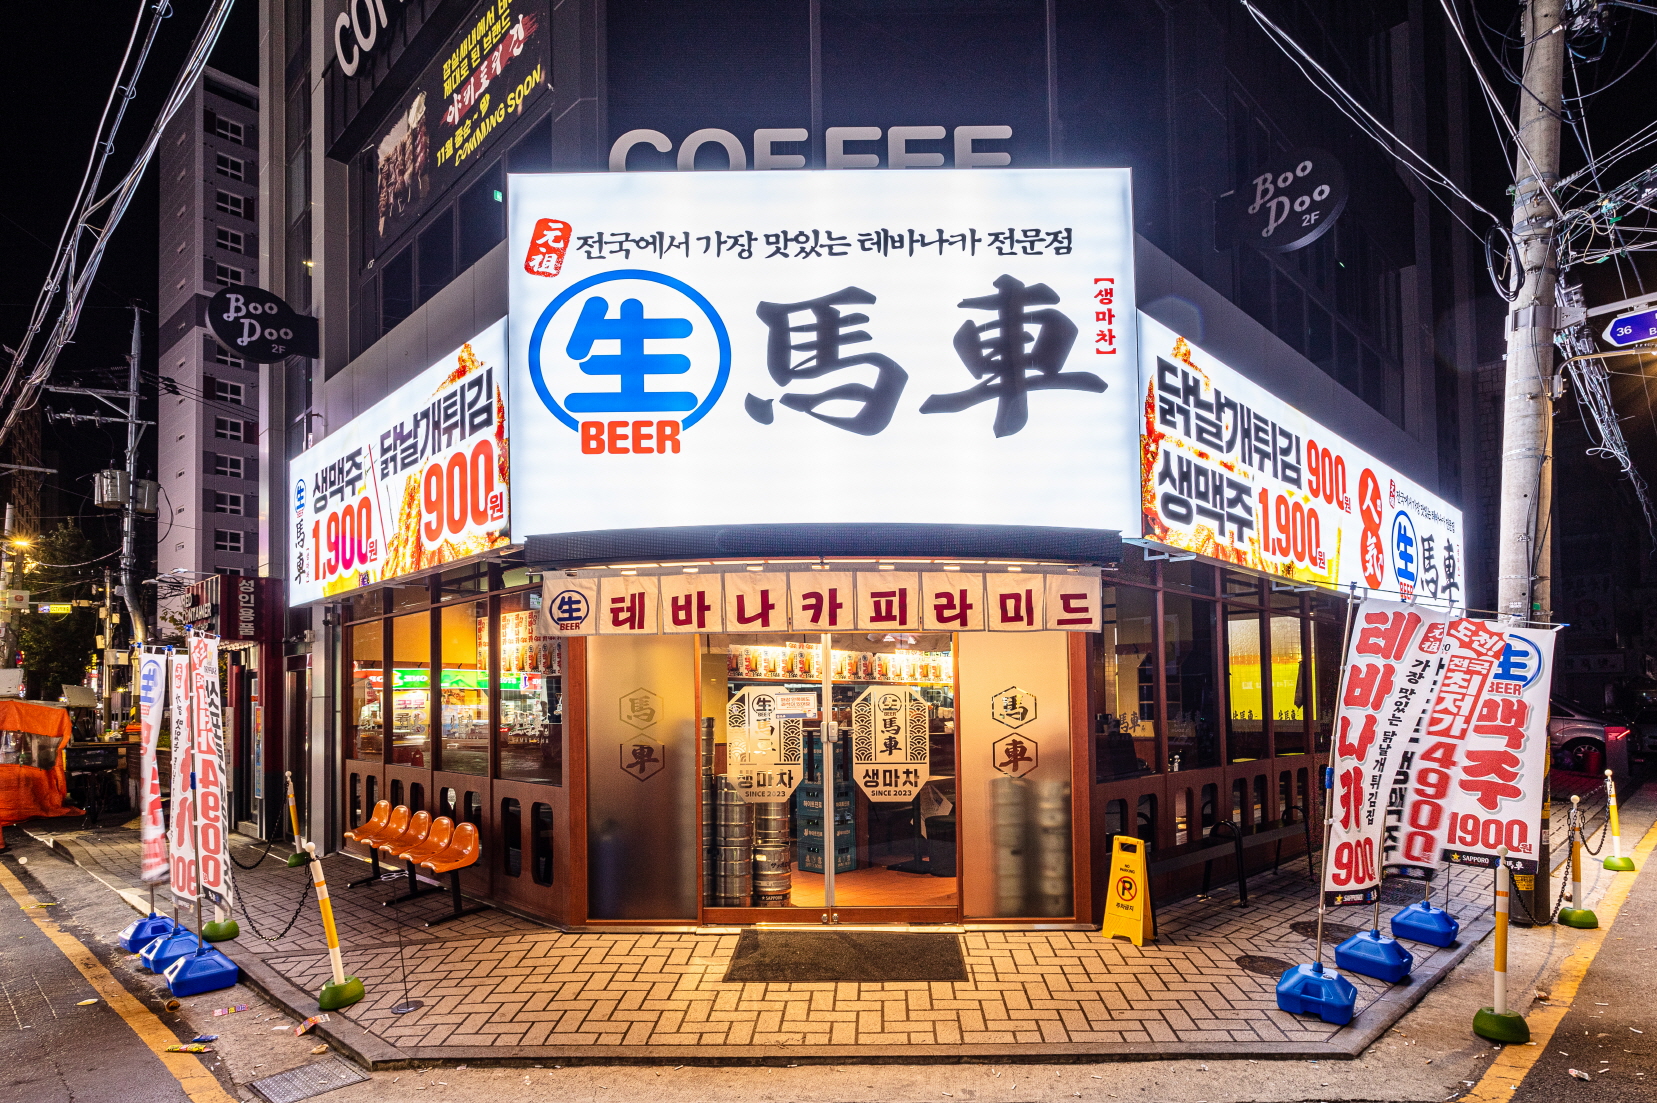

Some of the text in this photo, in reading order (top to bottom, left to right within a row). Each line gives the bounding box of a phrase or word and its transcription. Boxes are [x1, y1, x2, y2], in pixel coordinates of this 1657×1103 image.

[443, 58, 470, 99] 제대로
[471, 45, 481, 68] 된
[484, 9, 511, 55] 브랜드
[455, 64, 541, 167] COMMING SOON
[1248, 160, 1313, 214] Boo
[1262, 184, 1330, 237] Doo
[1302, 211, 1320, 227] 2F
[576, 227, 1073, 260] 전국에서 가장 맛있는 테바나카 전문점
[223, 294, 278, 321] Boo
[236, 318, 293, 346] Doo
[271, 344, 286, 354] 2F
[1616, 325, 1657, 337] 36 B
[564, 273, 1109, 438] 生 馬車
[380, 366, 494, 481] 닭날개튀김
[580, 420, 682, 455] BEER
[1156, 355, 1303, 491] 닭날개튀김
[312, 446, 363, 514] 생맥주
[1158, 448, 1255, 544] 생맥주
[238, 580, 255, 636] 성인용품
[557, 596, 582, 622] 生
[559, 622, 581, 631] BEER
[1450, 621, 1504, 656] 도전!
[1406, 658, 1431, 684] 가장
[1449, 657, 1490, 675] 전국
[1337, 611, 1422, 830] 테바나카
[1387, 687, 1416, 727] 맛있는
[1427, 671, 1477, 735] 최저가
[879, 717, 902, 756] 馬車
[1458, 698, 1529, 811] 맥주
[863, 768, 919, 788] 생마차
[1462, 854, 1489, 864] SAPPORO
